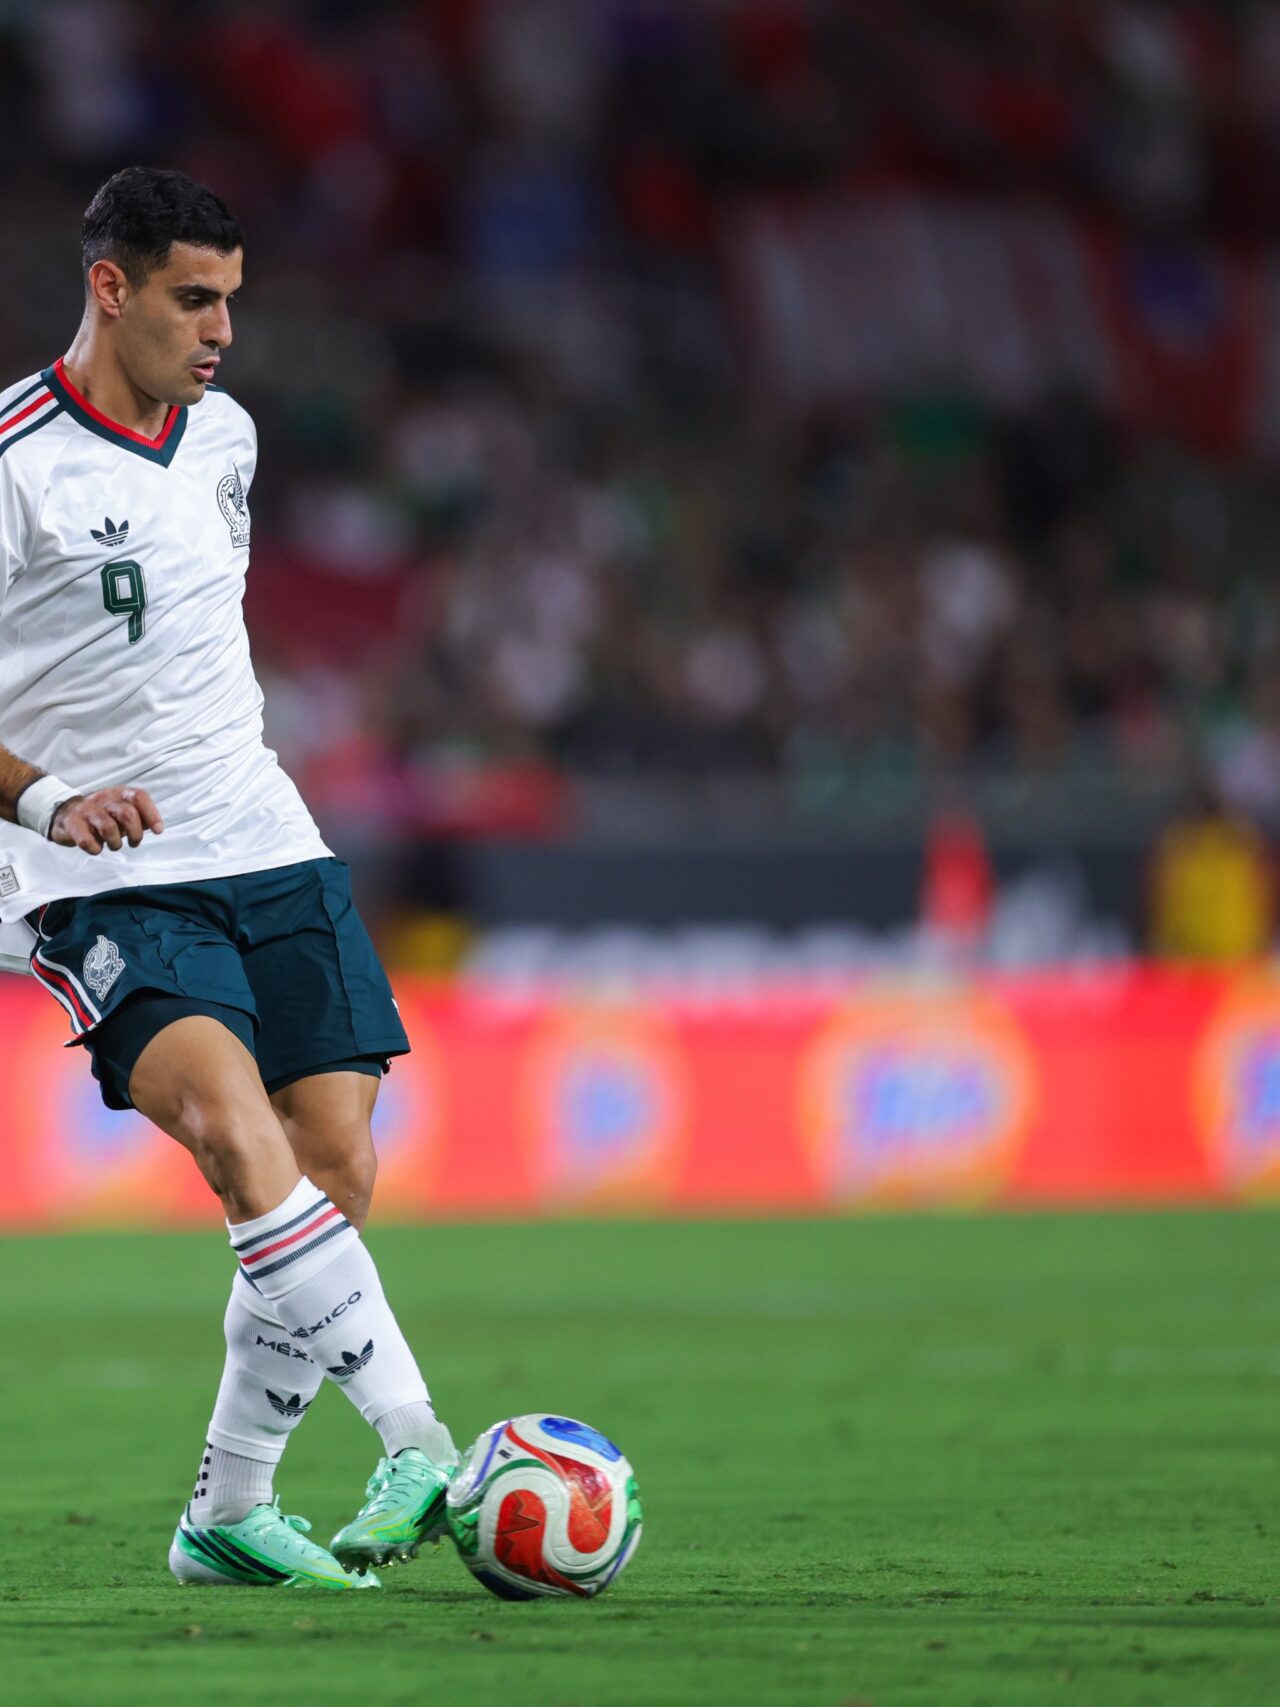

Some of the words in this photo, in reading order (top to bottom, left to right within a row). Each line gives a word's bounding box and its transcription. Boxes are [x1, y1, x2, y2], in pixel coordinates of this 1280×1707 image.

[232, 533, 250, 545] MEXIC
[100, 558, 148, 645] 9
[256, 1336, 314, 1364] MÉX
